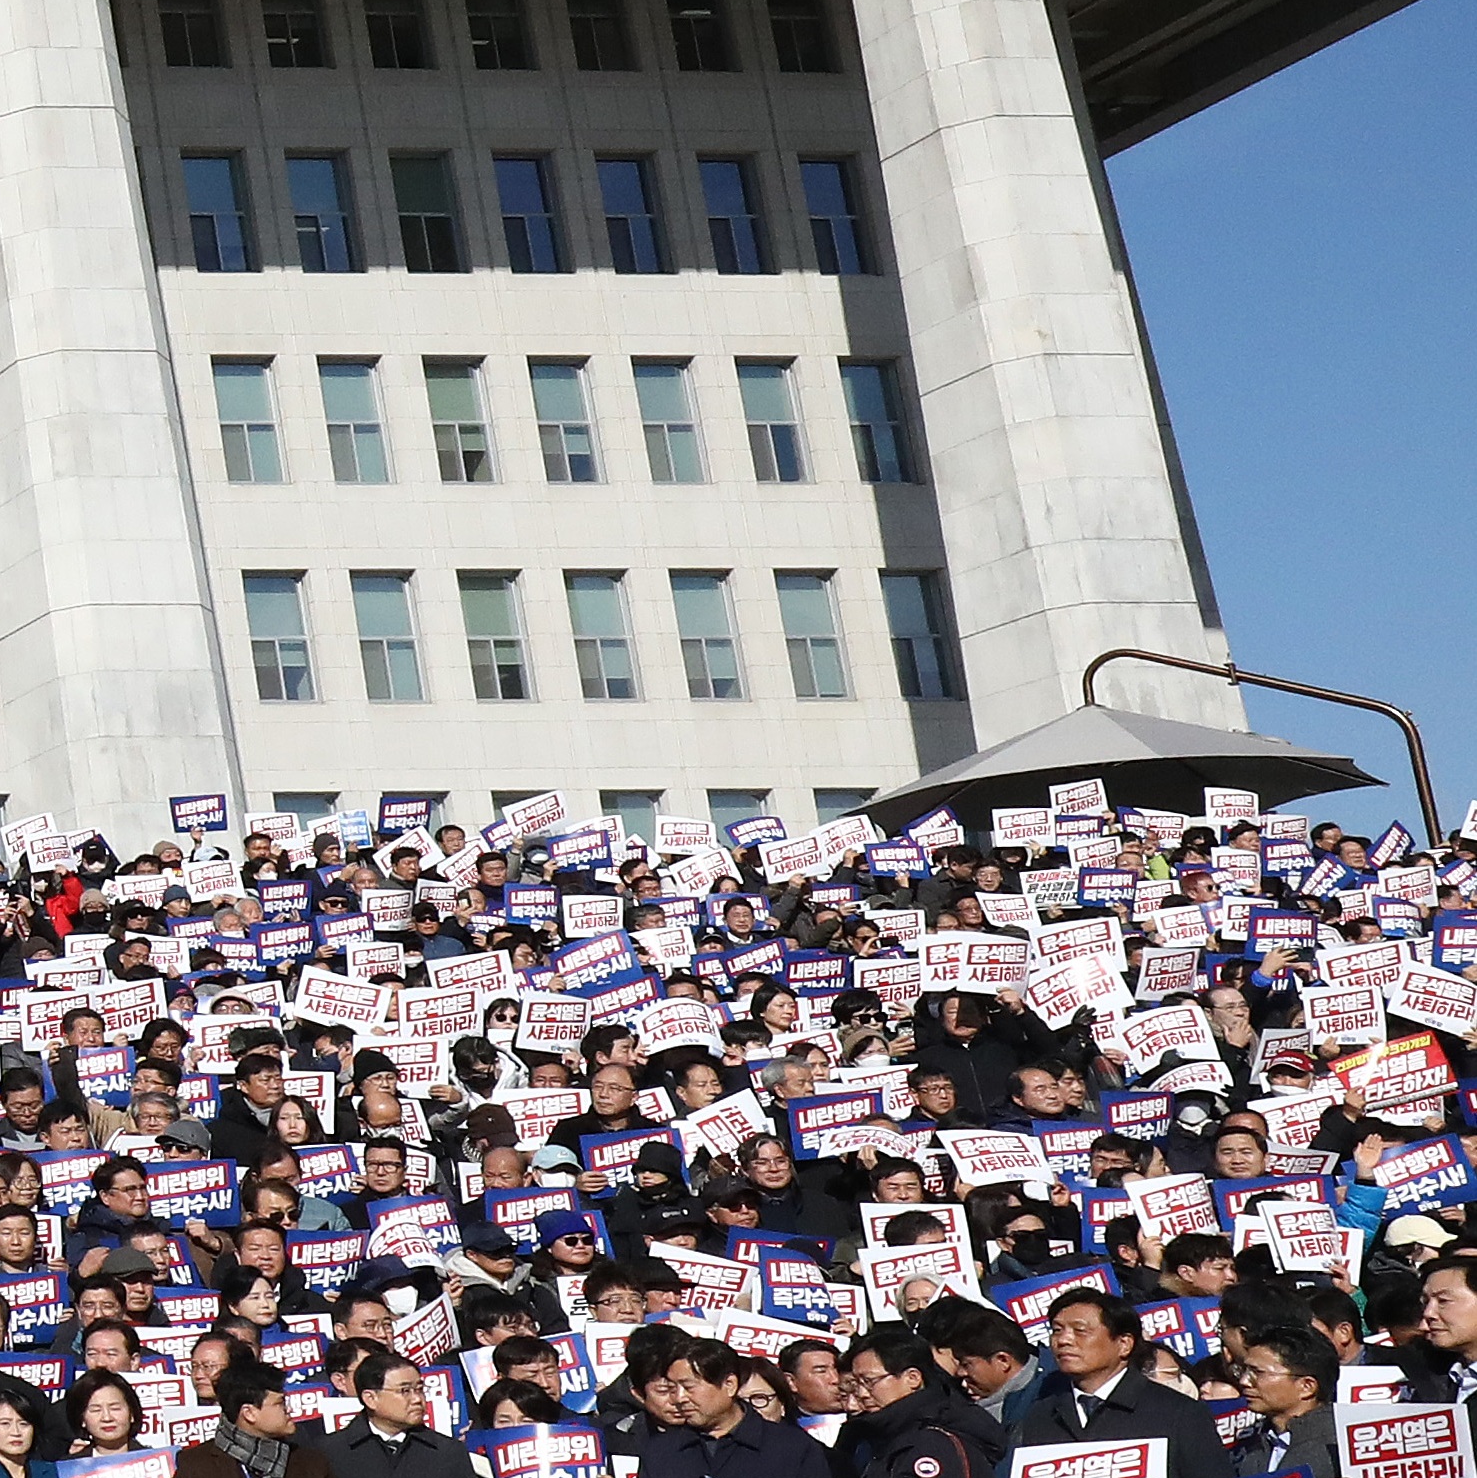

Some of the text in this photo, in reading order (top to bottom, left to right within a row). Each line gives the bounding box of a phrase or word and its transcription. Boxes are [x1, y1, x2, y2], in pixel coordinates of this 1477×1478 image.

[1002, 826, 1052, 841] 사퇴하라!
[310, 979, 383, 1002] 윤석열은
[304, 996, 380, 1022] 사퇴하라!
[408, 997, 477, 1019] 윤석열은
[530, 1002, 586, 1022] 윤석열은
[1309, 996, 1373, 1019] 윤석열은
[410, 1015, 479, 1036] 사퇴하라!
[525, 1020, 586, 1041] 사퇴하라!
[1121, 1011, 1200, 1048] 윤석열은
[1317, 1011, 1379, 1034] 사퇴하라!
[1138, 1030, 1207, 1061] 사퇴하라!
[955, 1137, 1024, 1159] 윤석열은
[970, 1150, 1040, 1170] 사퇴하라!
[148, 1165, 228, 1195] 내란행위
[150, 1187, 233, 1219] 즉각수사!
[1353, 1415, 1453, 1460] 윤석열은
